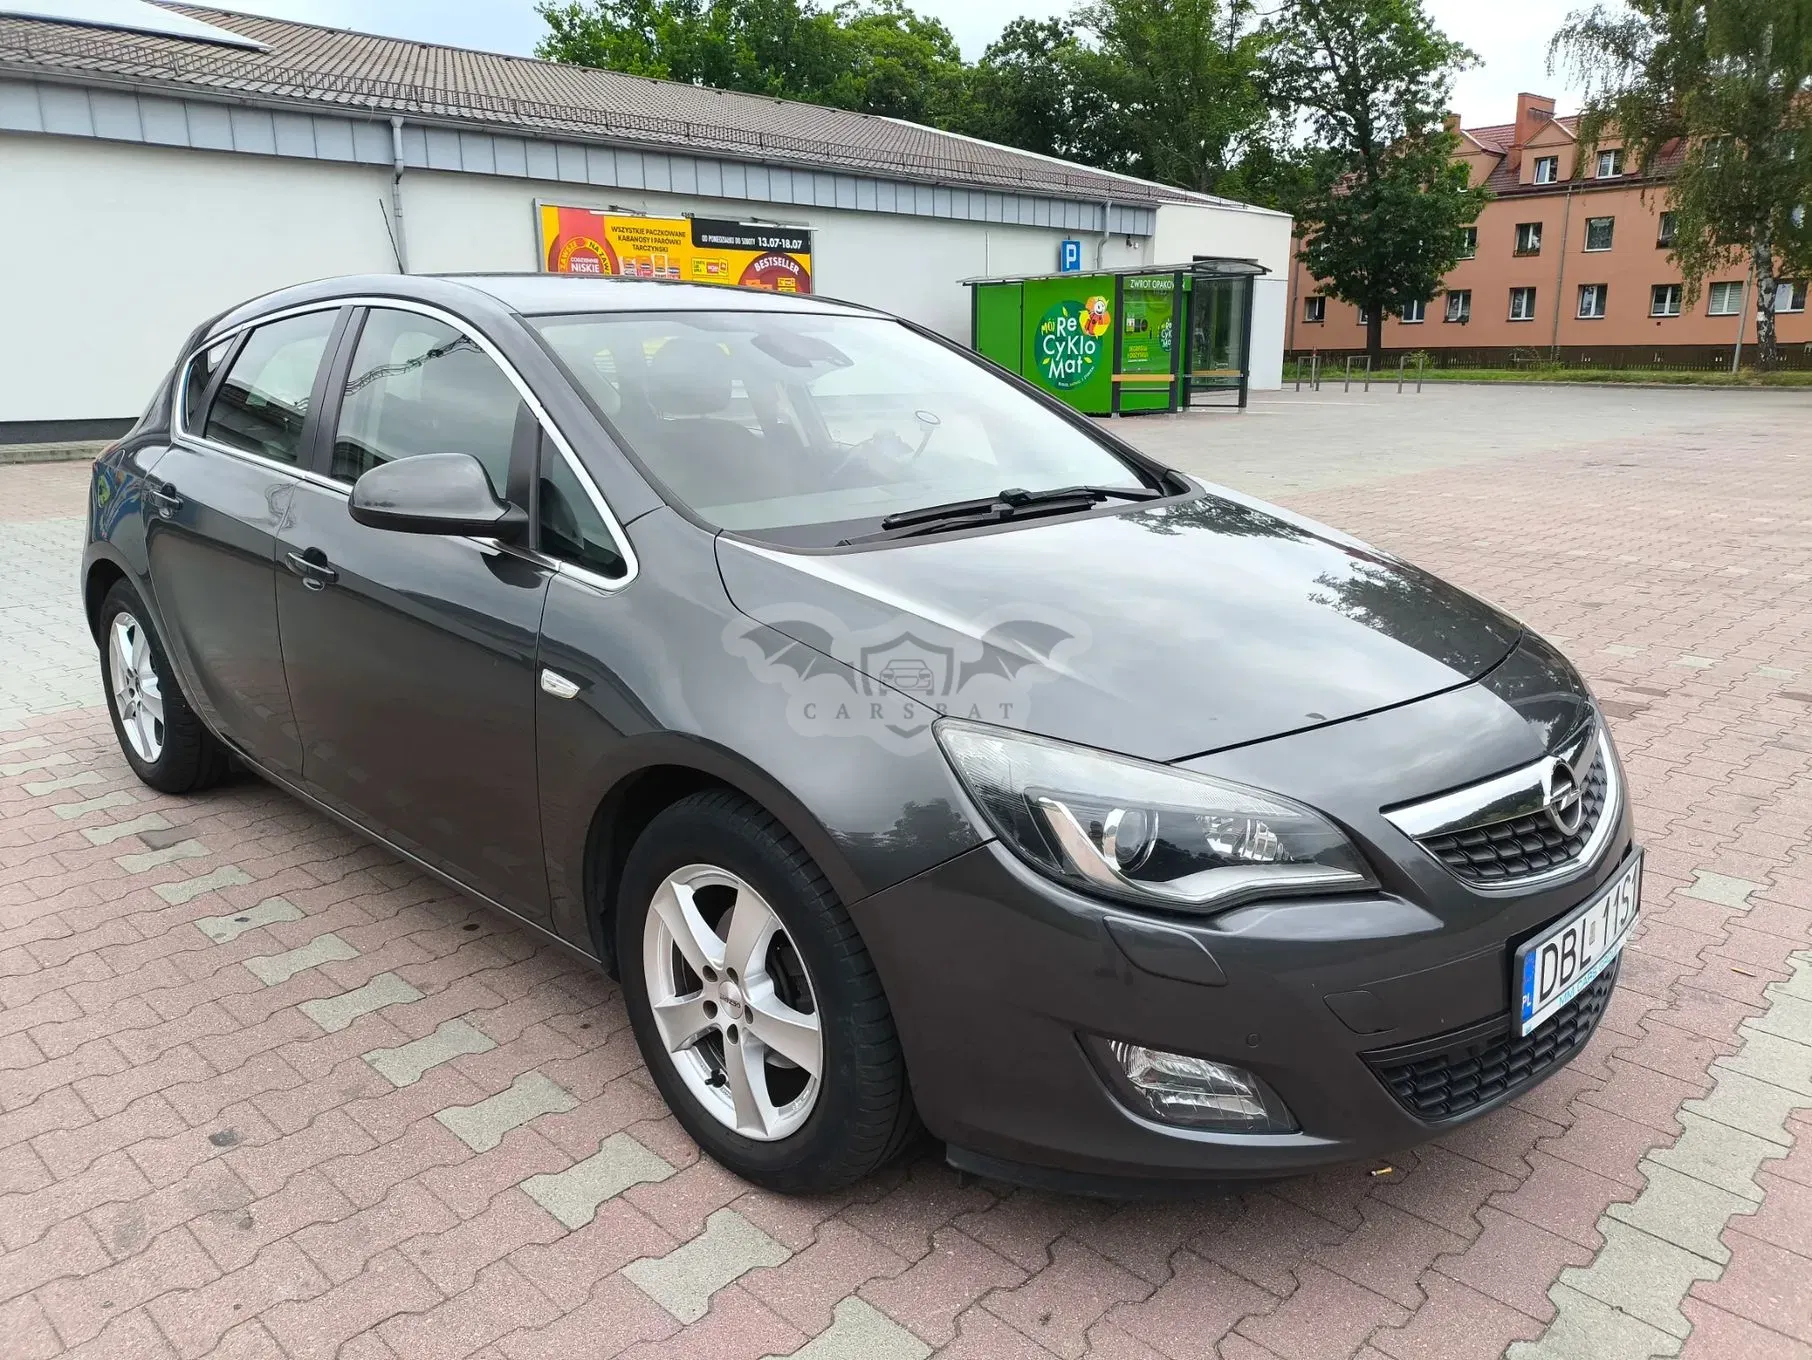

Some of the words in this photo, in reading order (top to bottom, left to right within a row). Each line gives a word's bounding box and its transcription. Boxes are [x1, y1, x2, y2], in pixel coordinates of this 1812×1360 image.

[611, 226, 645, 235] WSZYSTKIE
[758, 236, 802, 249] 13.07-18.07
[1066, 244, 1077, 268] P
[570, 263, 600, 273] NISKIE
[753, 256, 800, 275] BESTSELLER
[1130, 279, 1151, 289] ZWROT
[1048, 355, 1083, 379] Mat
[1539, 918, 1592, 1003] DBL
[1522, 993, 1532, 1007] PL
